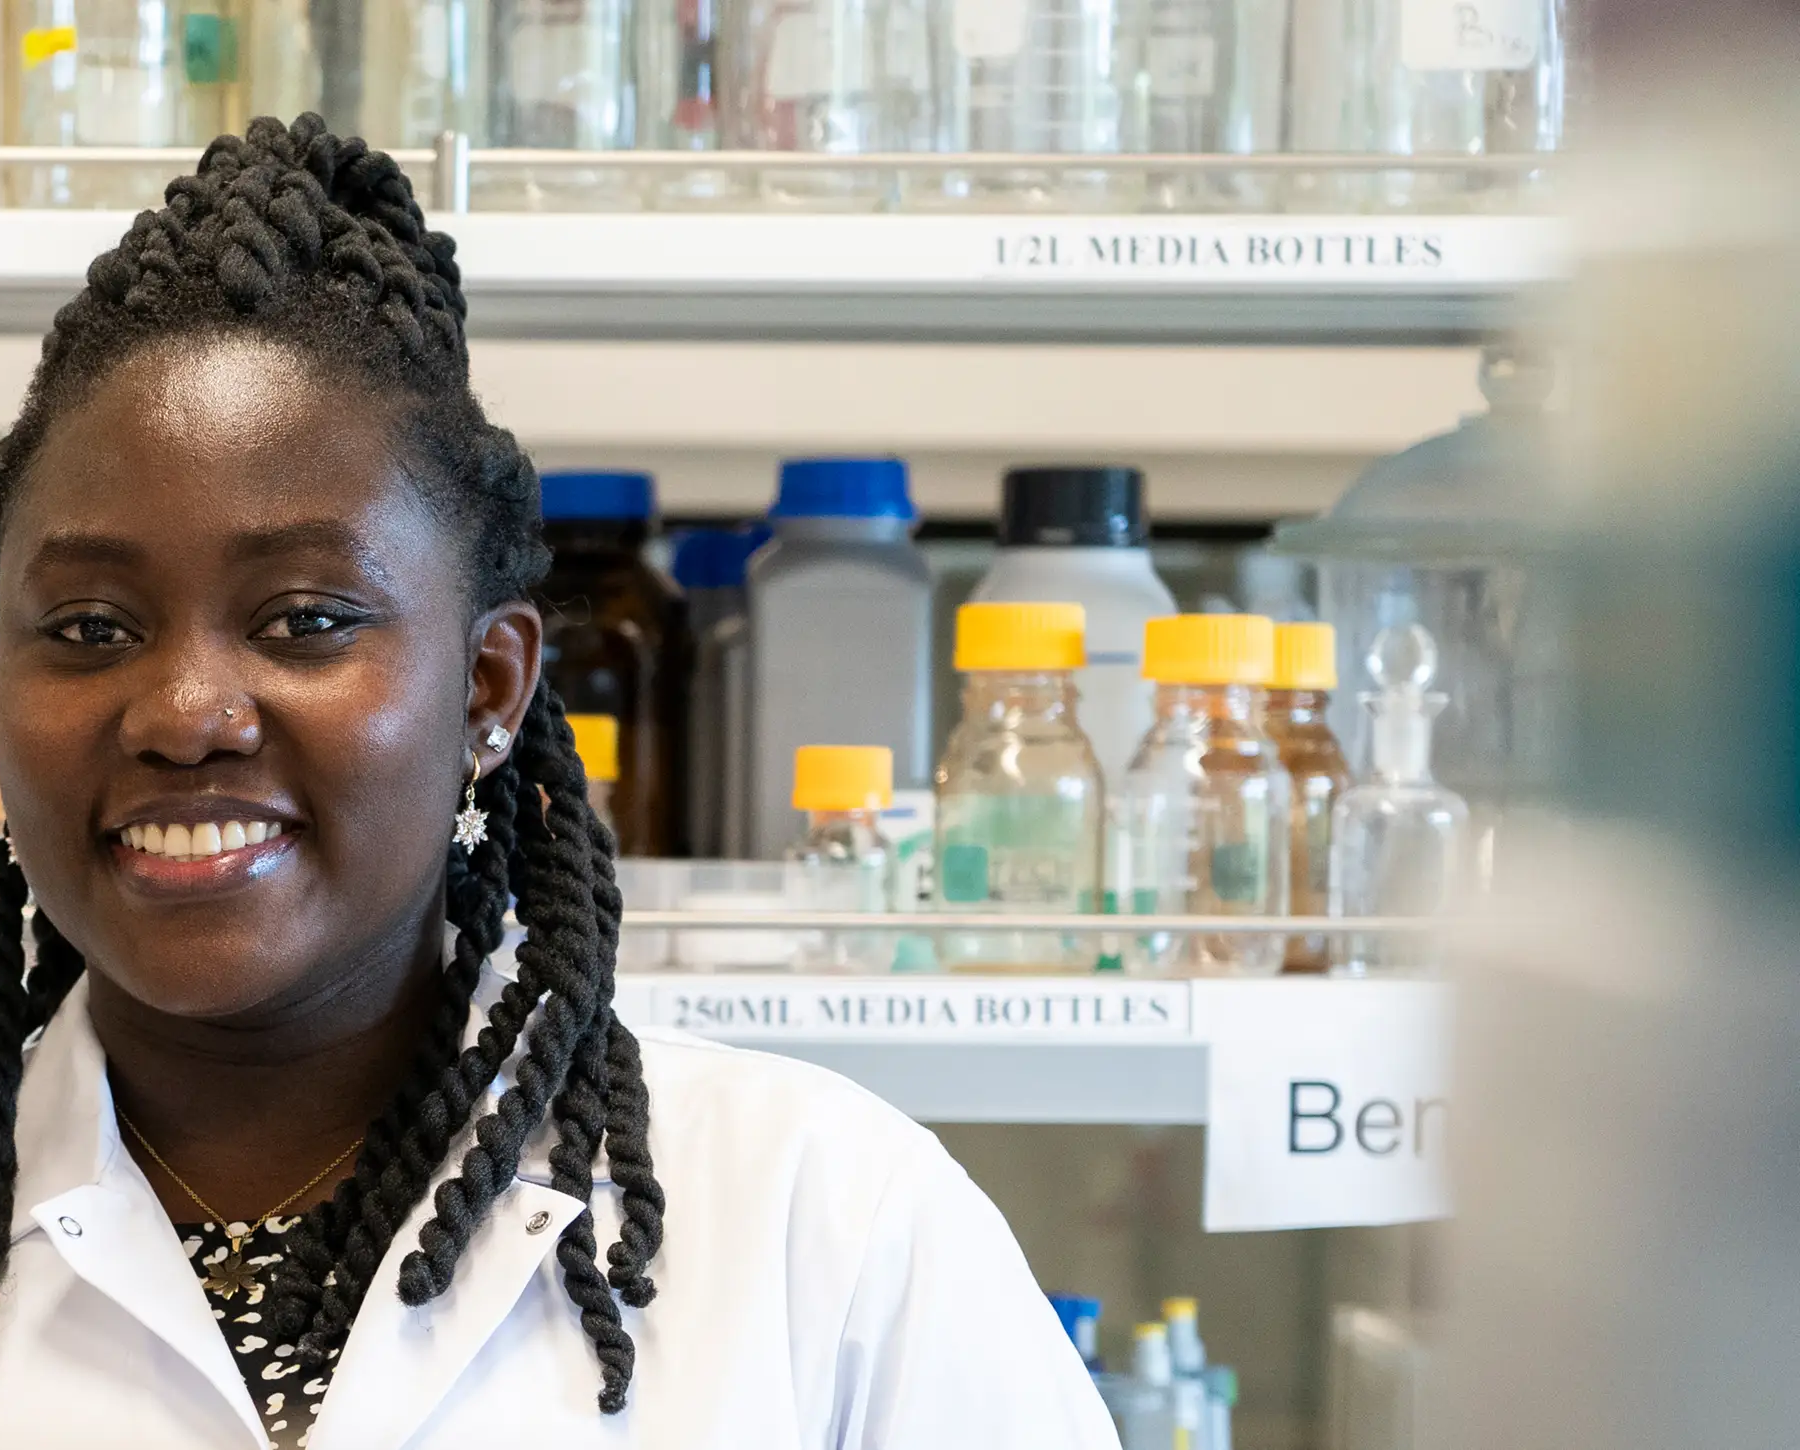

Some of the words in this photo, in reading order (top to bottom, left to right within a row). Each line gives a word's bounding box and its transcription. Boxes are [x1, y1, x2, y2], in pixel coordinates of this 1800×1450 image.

[995, 235, 1073, 266] 1/2L
[1087, 235, 1230, 266] MEDIA
[1247, 235, 1444, 266] BOTTLES
[672, 995, 804, 1029] 250ML
[817, 995, 958, 1027] MEDIA
[974, 994, 1171, 1026] BOTTLES
